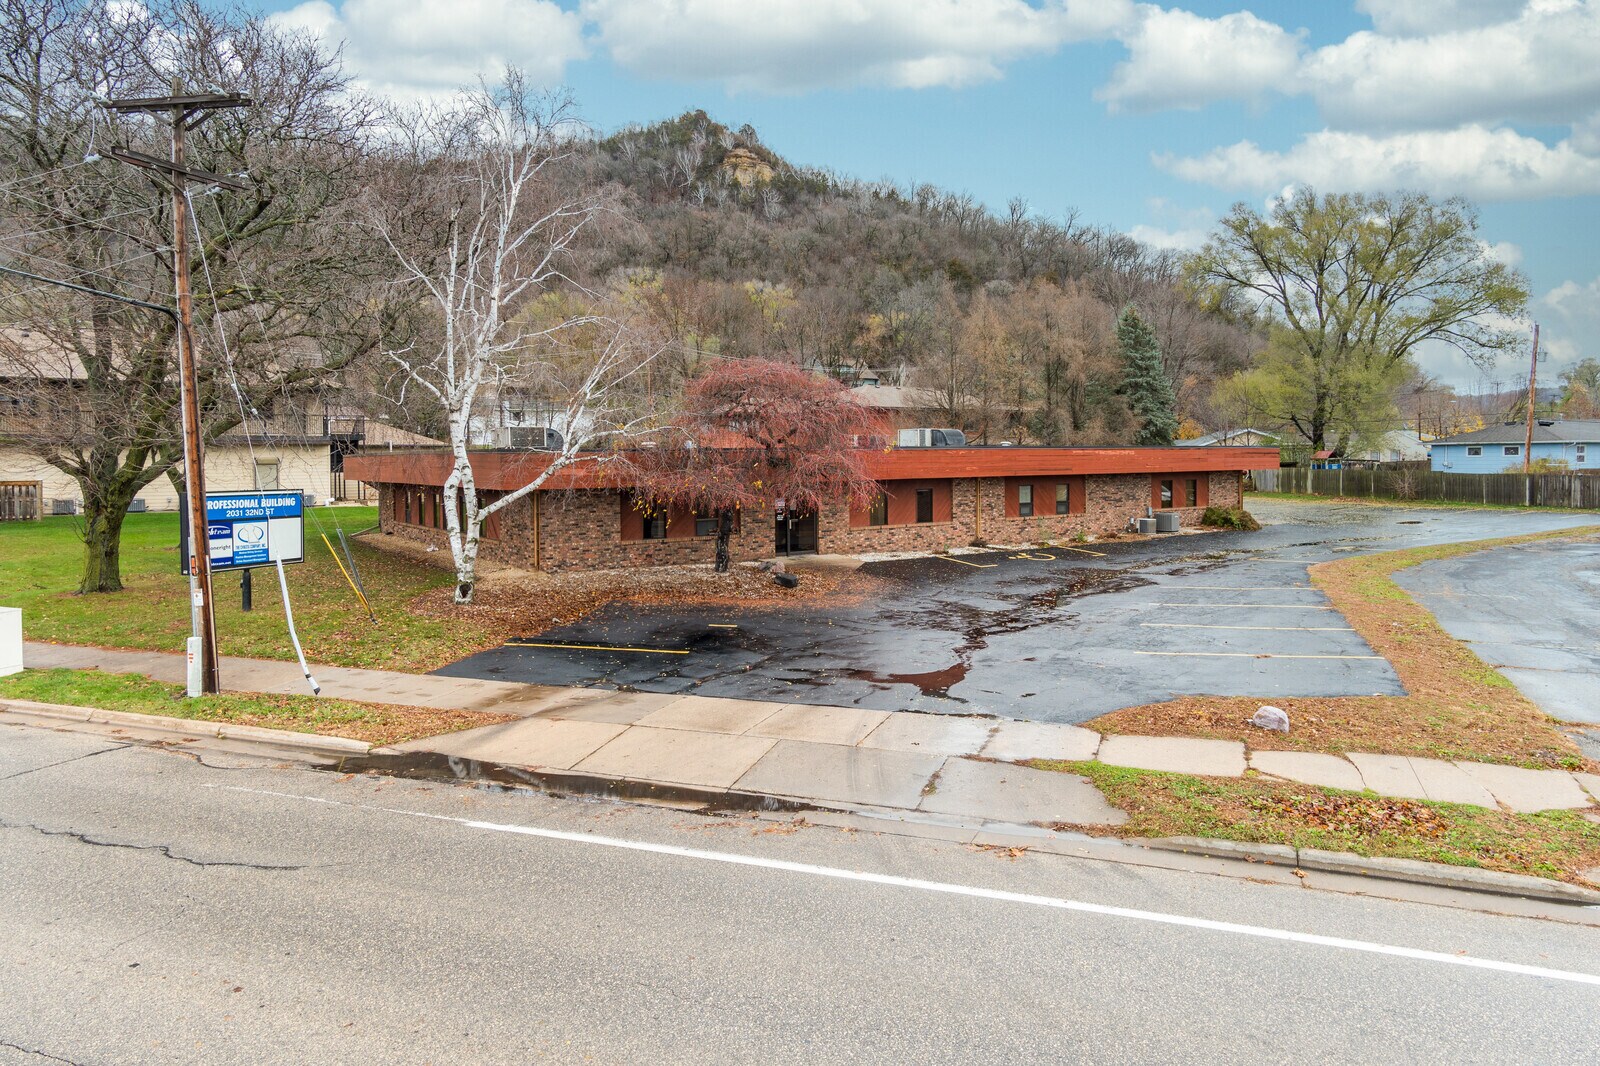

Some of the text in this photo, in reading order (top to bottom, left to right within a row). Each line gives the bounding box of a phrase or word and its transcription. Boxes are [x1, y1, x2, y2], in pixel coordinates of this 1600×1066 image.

[206, 497, 296, 510] ROFESSIONAL BUILDING
[245, 508, 264, 516] 32ND
